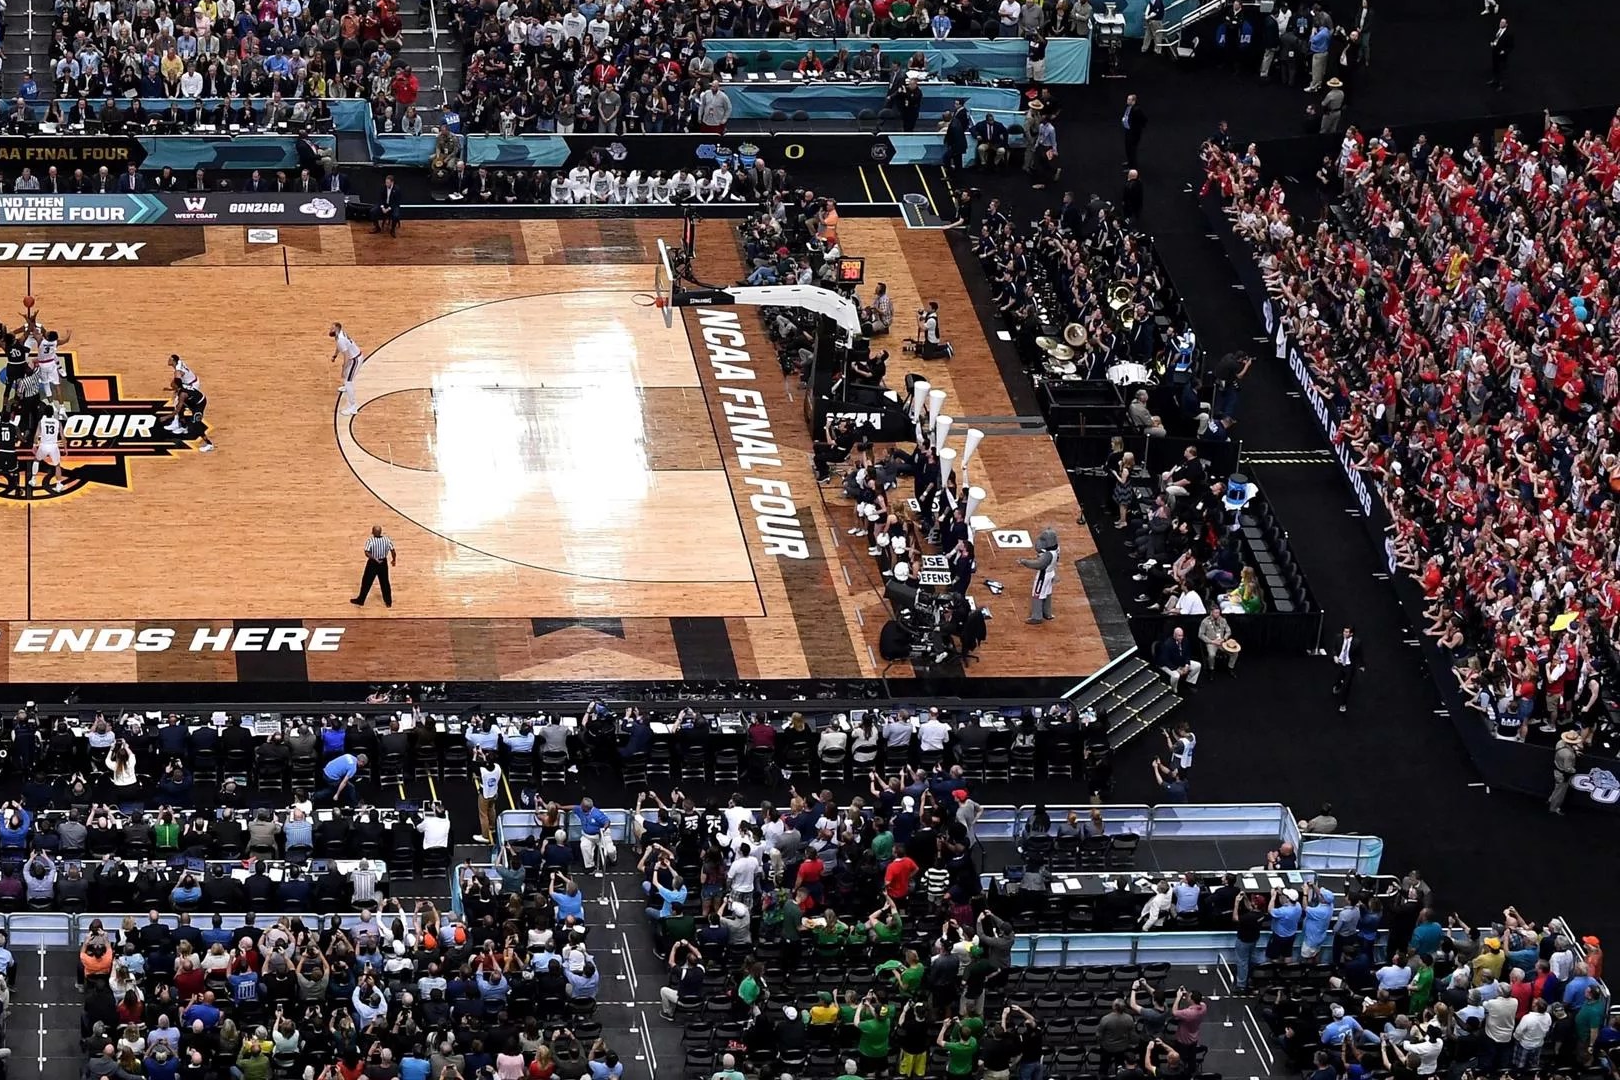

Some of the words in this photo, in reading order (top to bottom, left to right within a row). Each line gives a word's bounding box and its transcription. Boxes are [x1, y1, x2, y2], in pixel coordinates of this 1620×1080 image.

[26, 147, 78, 161] FINAL
[82, 147, 129, 161] FOUR
[27, 197, 64, 208] THEN
[229, 203, 285, 213] GONZAGA
[5, 207, 65, 221] WERE
[69, 207, 125, 221] FOUR
[696, 308, 757, 380] NCAA
[45, 425, 55, 435] 13
[64, 414, 157, 438] OUR
[718, 386, 782, 470] FINAL
[1, 431, 10, 441] 10
[743, 476, 810, 560] FOUR
[921, 573, 951, 584] EFENS
[12, 628, 176, 652] ENDS
[188, 627, 347, 652] HERE
